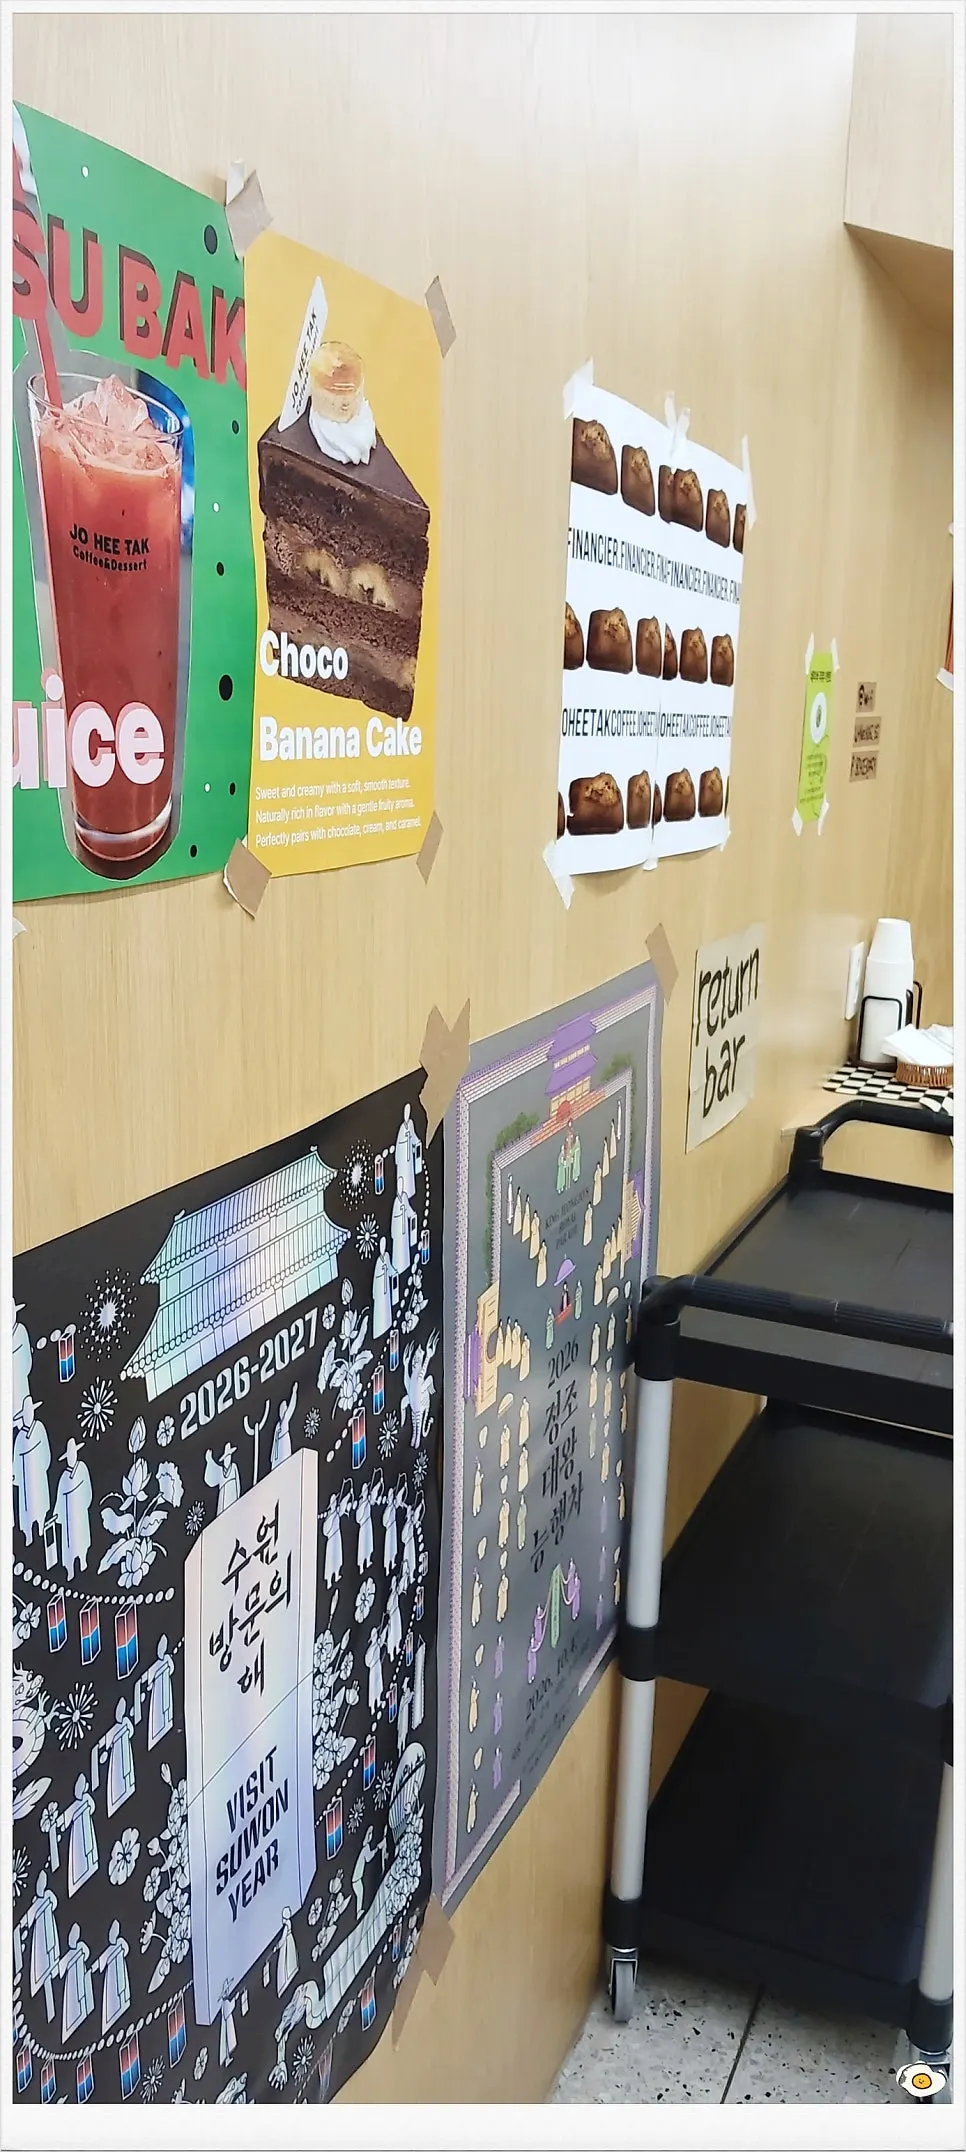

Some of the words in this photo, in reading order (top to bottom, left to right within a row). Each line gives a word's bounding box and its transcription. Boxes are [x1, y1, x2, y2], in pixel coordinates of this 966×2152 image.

[69, 523, 88, 544] JO
[94, 532, 120, 555] HEE
[125, 537, 149, 556] TAK
[73, 545, 147, 571] Coffee&Dessert
[260, 630, 348, 680] Choco
[260, 716, 360, 761] Banana
[366, 716, 422, 757] Cake
[255, 786, 280, 800] Sweet
[281, 784, 296, 798] and
[297, 784, 325, 798] creamy
[326, 782, 341, 795] with
[342, 784, 347, 793] a
[348, 780, 363, 795] soft,
[363, 779, 388, 791] smooth
[255, 808, 290, 824] Naturally
[291, 807, 305, 820] rich
[306, 806, 313, 818] in
[314, 804, 335, 818] flavor
[336, 803, 351, 815] with
[352, 804, 357, 814] a
[357, 800, 378, 817] gentle
[255, 832, 290, 848] Perfectly
[291, 829, 310, 846] pairs
[311, 826, 326, 841] with
[327, 823, 362, 839] chocolate,
[363, 822, 385, 835] cream,
[385, 820, 397, 831] and
[696, 947, 759, 1047] return
[703, 1034, 745, 1118] bar
[179, 1307, 318, 1441] 2026-2027
[547, 1334, 579, 1389] 2026
[543, 1379, 578, 1446] 정조
[541, 1426, 578, 1500] 대왕
[221, 1498, 279, 1595] 수원
[530, 1470, 584, 1574] 능행차
[209, 1549, 292, 1673] 방문의
[237, 1637, 265, 1697] 해
[226, 1745, 277, 1834] VISIT
[216, 1778, 289, 1896] SUWON
[228, 1838, 279, 1923] YEAR
